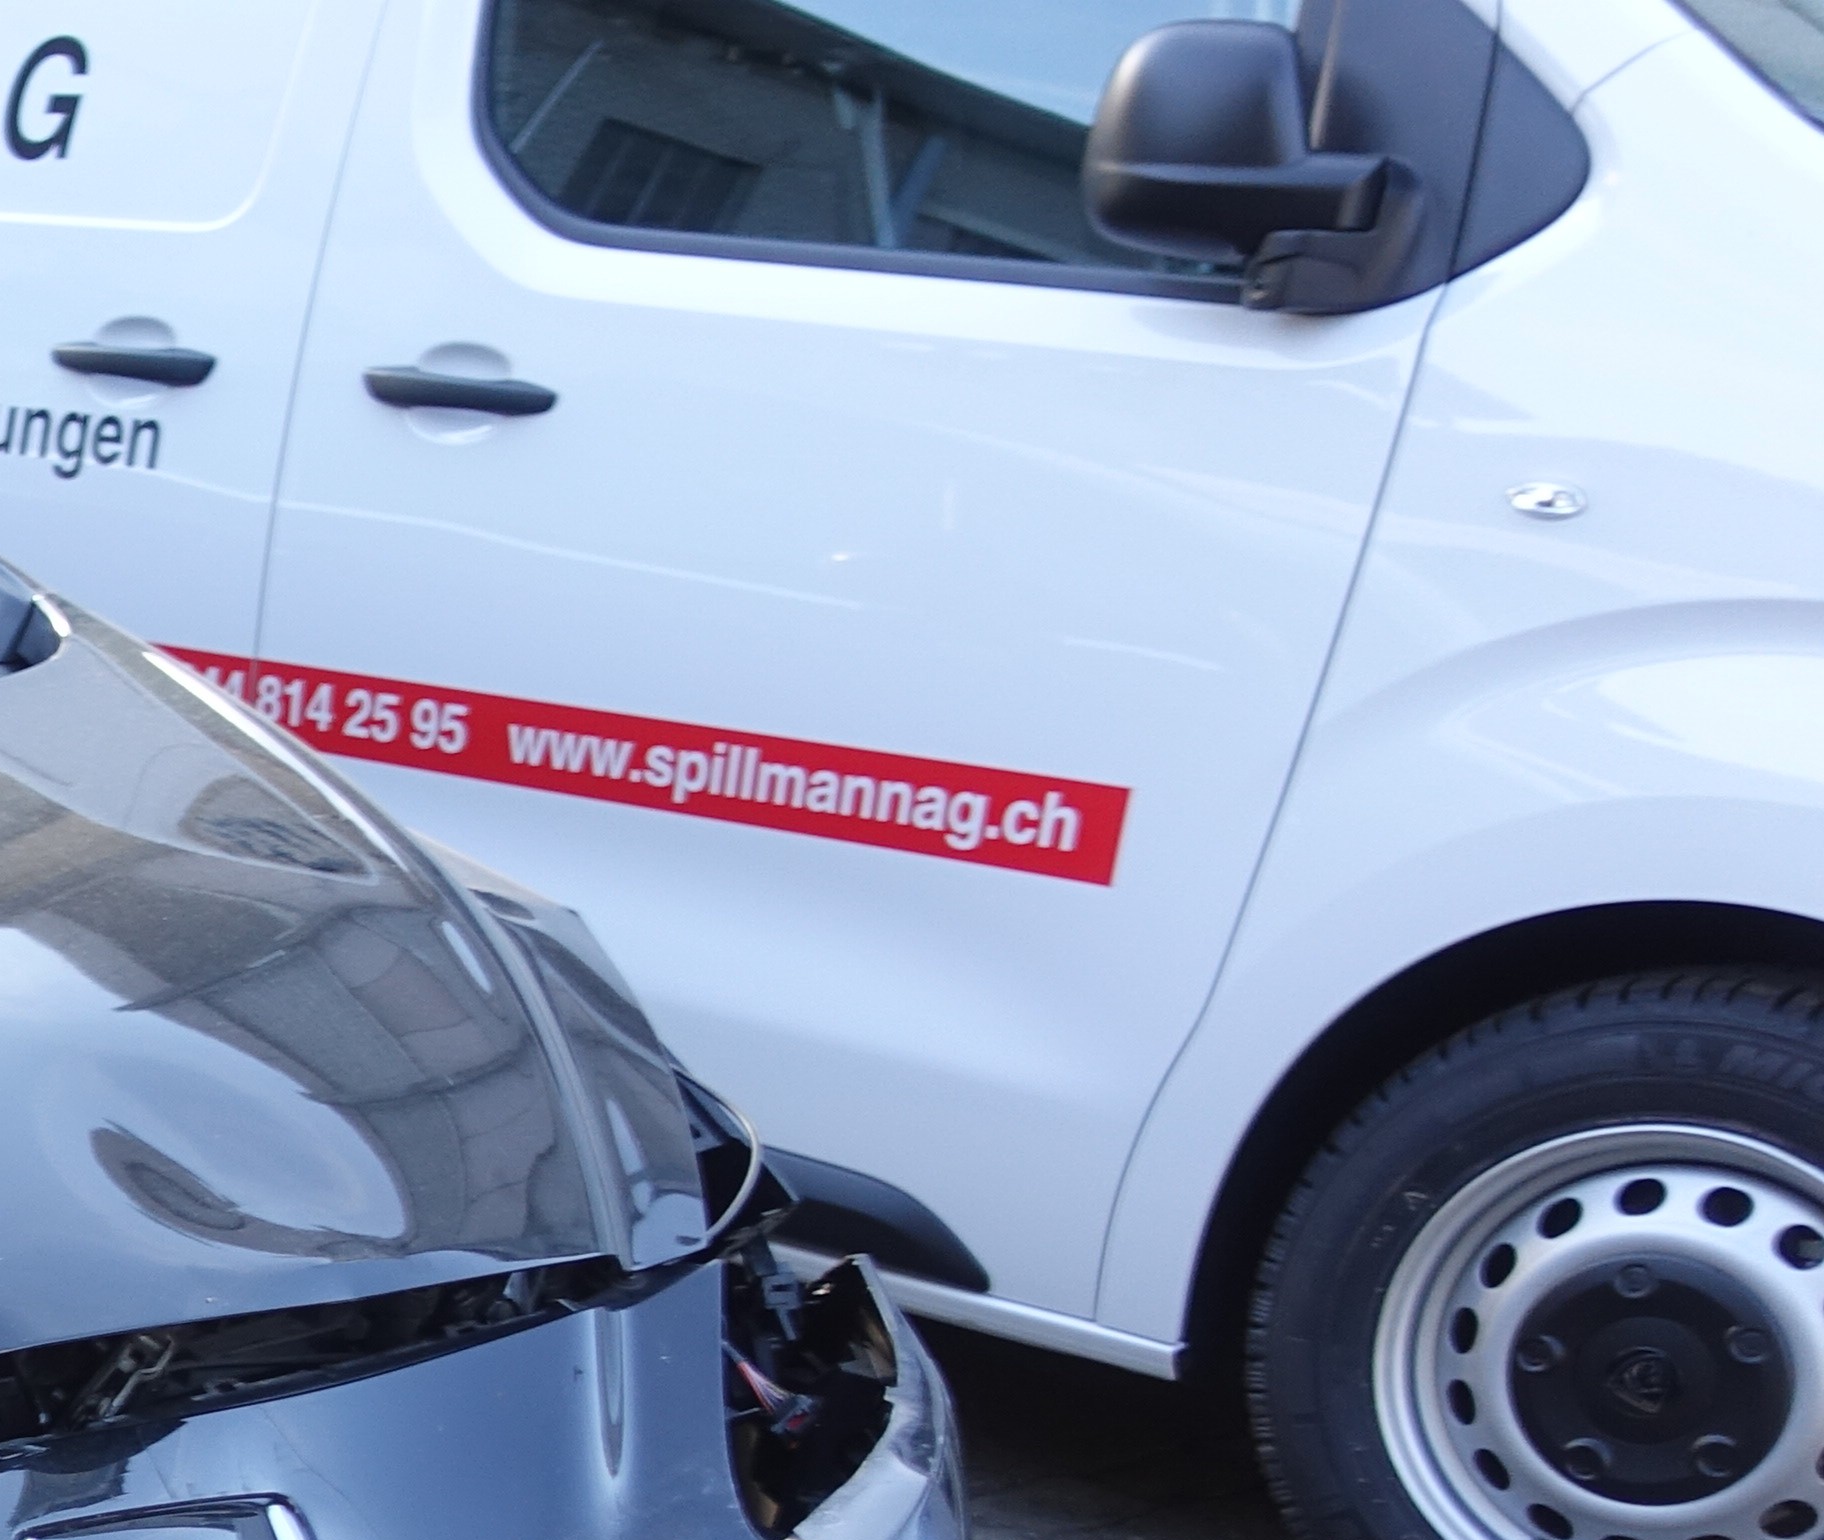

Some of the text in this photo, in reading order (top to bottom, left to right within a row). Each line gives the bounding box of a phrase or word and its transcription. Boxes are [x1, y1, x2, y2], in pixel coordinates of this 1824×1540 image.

[256, 674, 336, 731] 814
[342, 687, 400, 742] 25
[409, 698, 470, 754] 95
[508, 724, 1080, 852] www.spillmannag.ch
